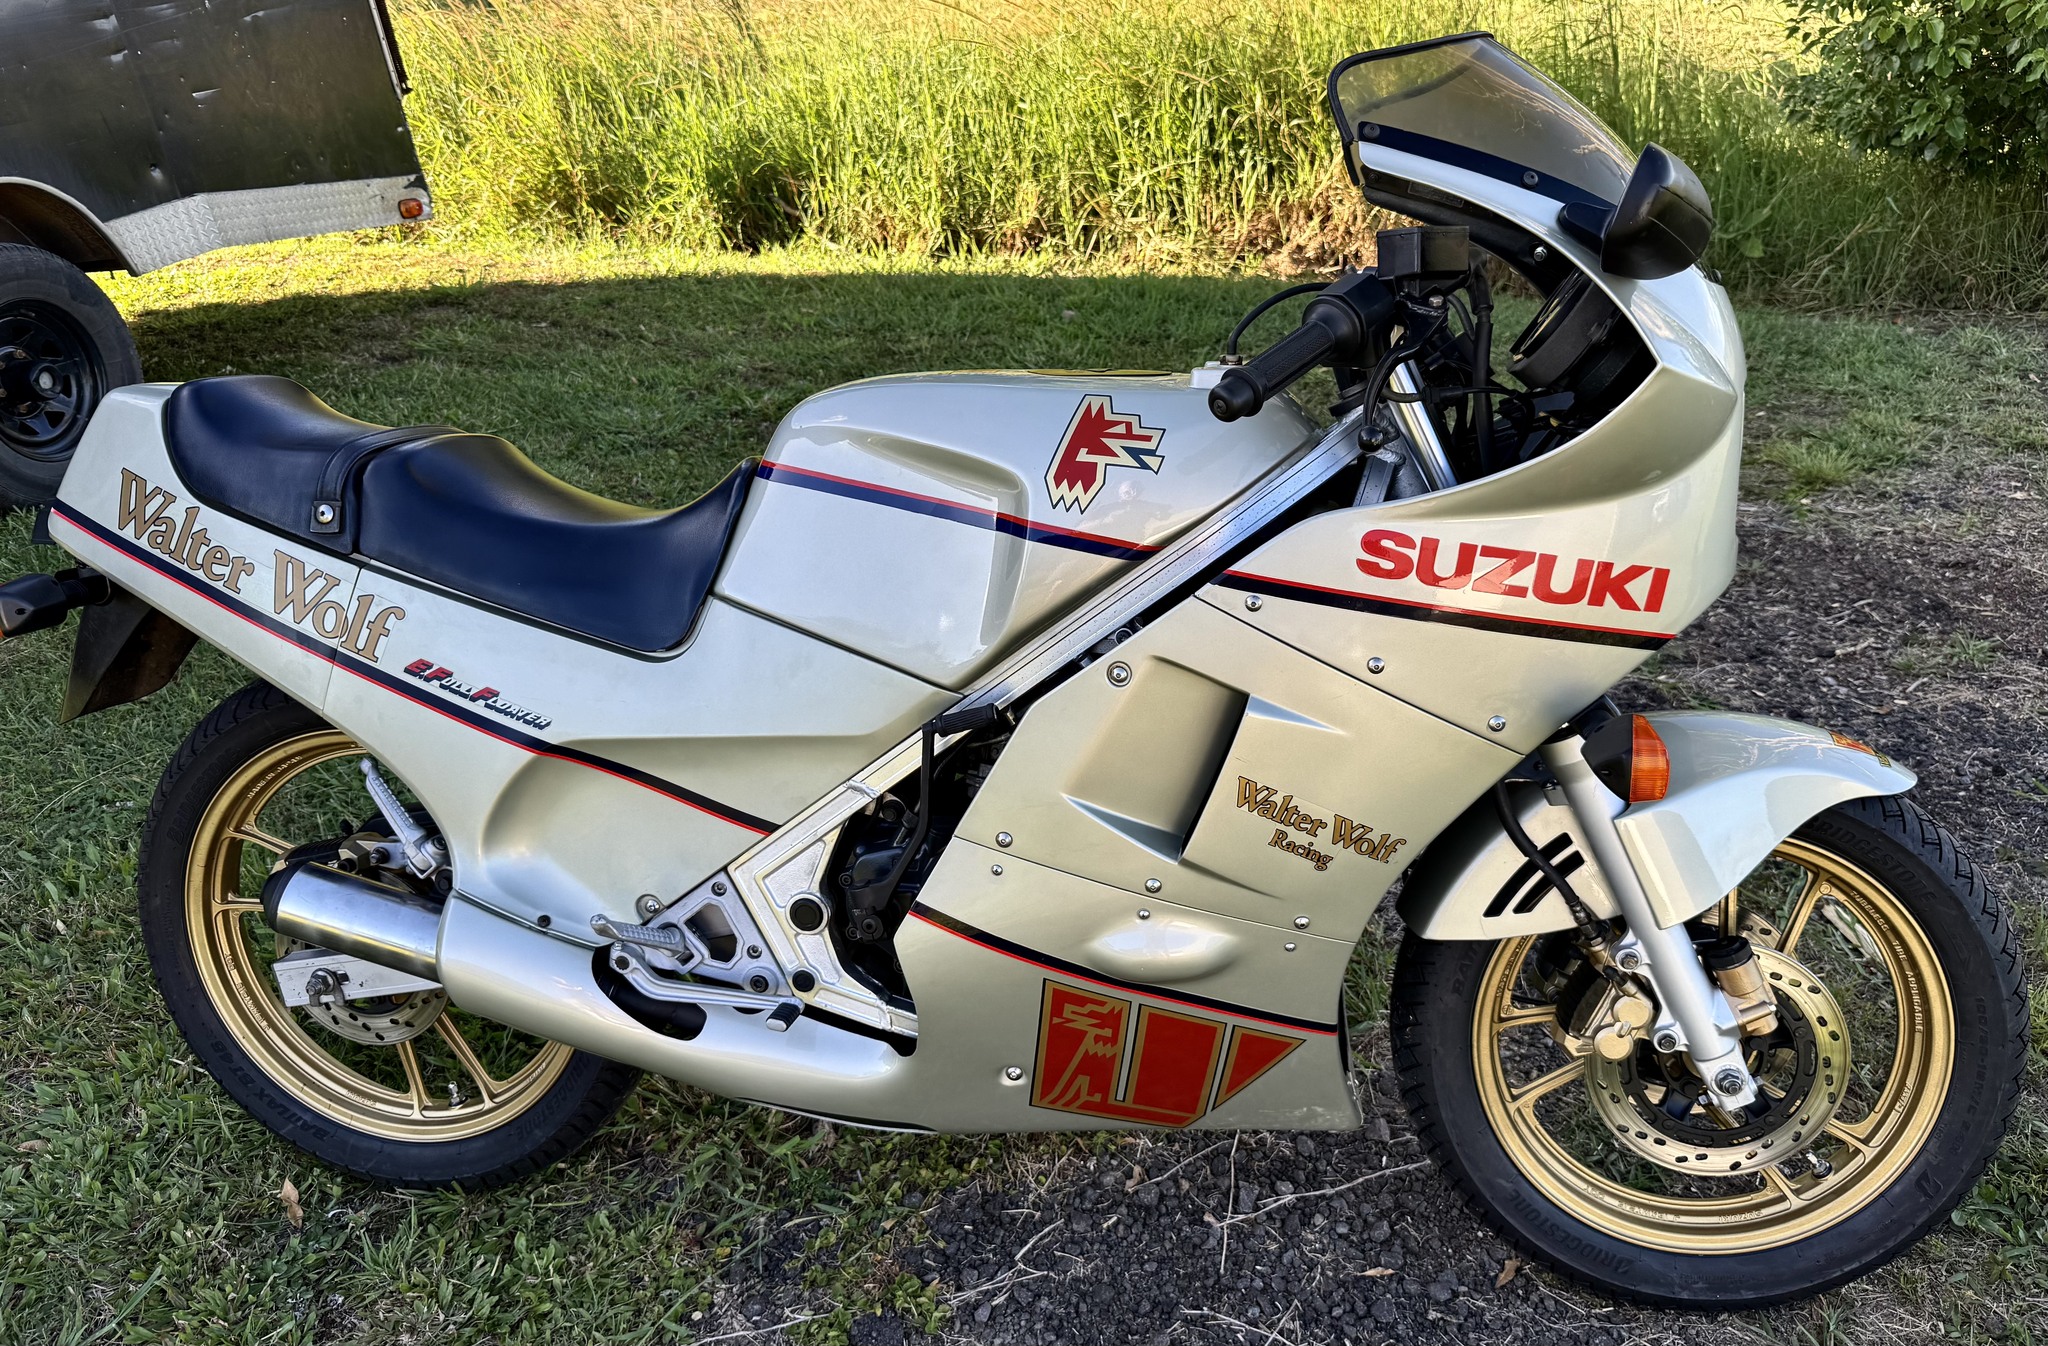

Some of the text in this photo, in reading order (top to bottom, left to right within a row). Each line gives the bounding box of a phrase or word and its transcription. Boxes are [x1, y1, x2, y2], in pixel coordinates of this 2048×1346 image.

[118, 467, 406, 663] Walter Wolf
[1356, 529, 1671, 613] SUZUKI
[1236, 775, 1407, 864] Walter Wolf
[1268, 828, 1333, 871] Racing
[1803, 815, 1937, 900] BRIDGESTONE
[253, 1086, 332, 1141] BATTLAX
[1510, 1187, 1636, 1276] BRIDGESTONE
